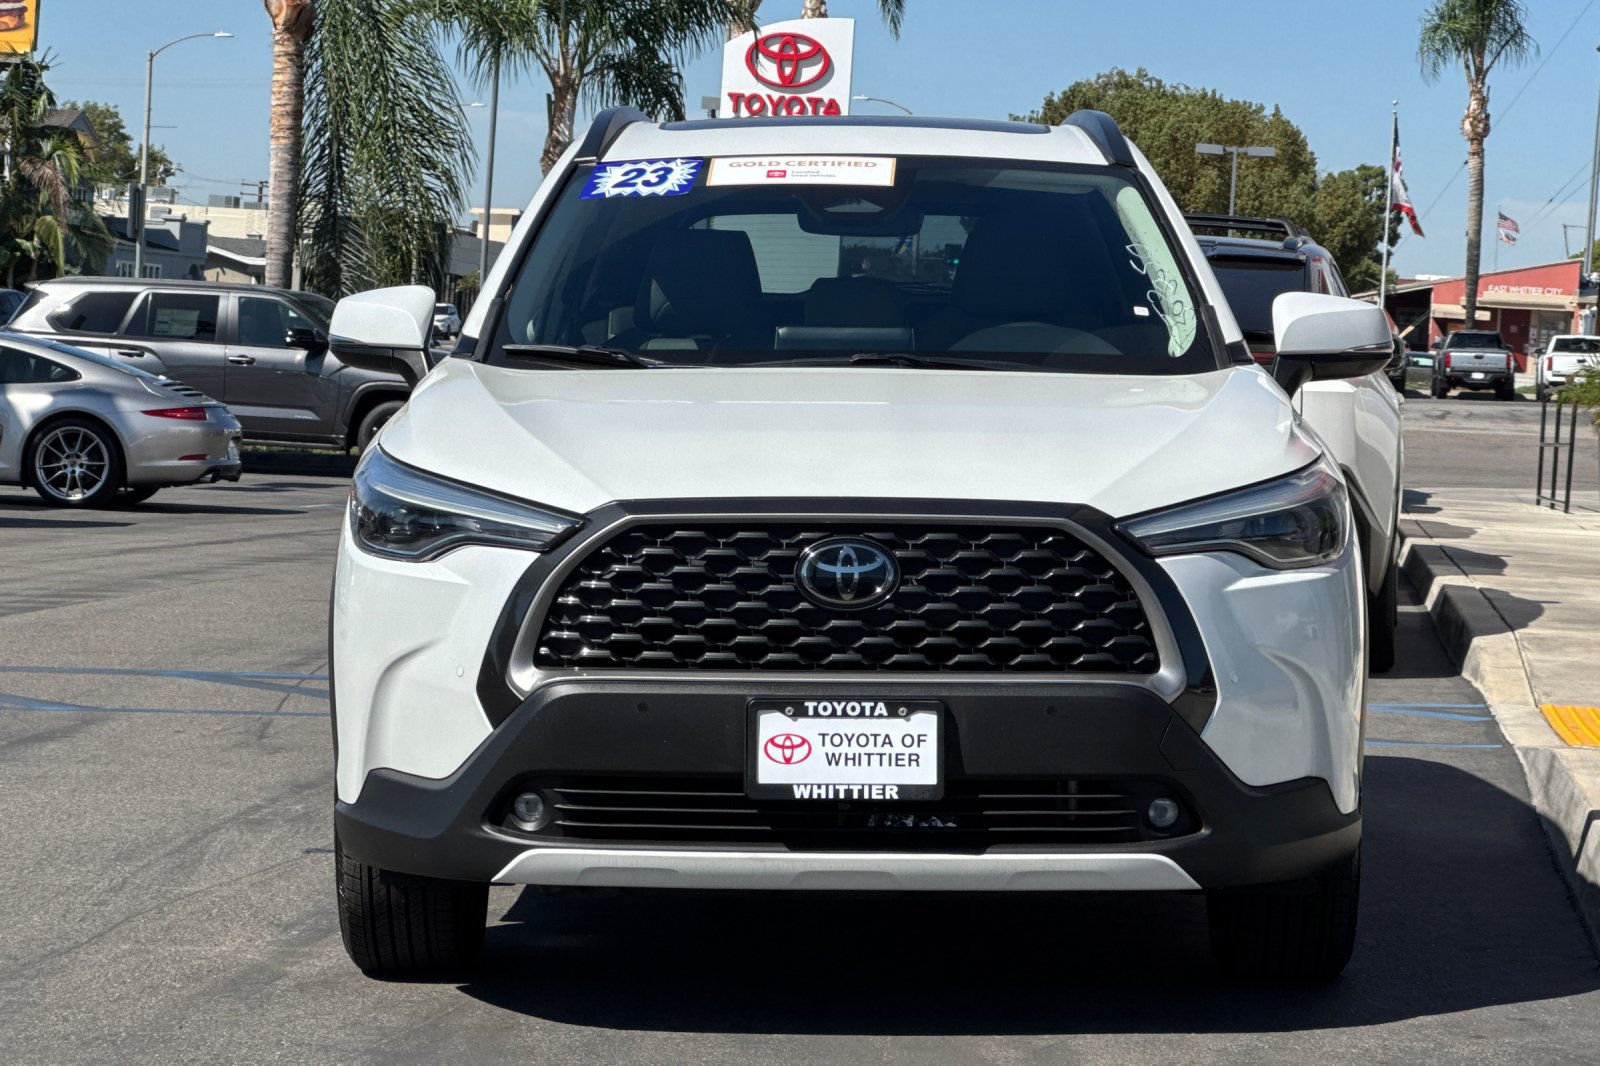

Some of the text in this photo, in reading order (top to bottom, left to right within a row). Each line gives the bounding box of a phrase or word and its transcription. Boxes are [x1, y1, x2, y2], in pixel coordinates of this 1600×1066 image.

[727, 92, 841, 116] TOYOTA
[785, 160, 878, 168] CERTIFIED
[611, 166, 674, 189] 23
[1488, 284, 1563, 296] EAST WHITTIER CITY
[804, 702, 888, 717] TOYOTA
[818, 733, 928, 748] TOYOTA OF
[825, 752, 920, 767] WHITTIER
[793, 784, 899, 799] WHITTIER
